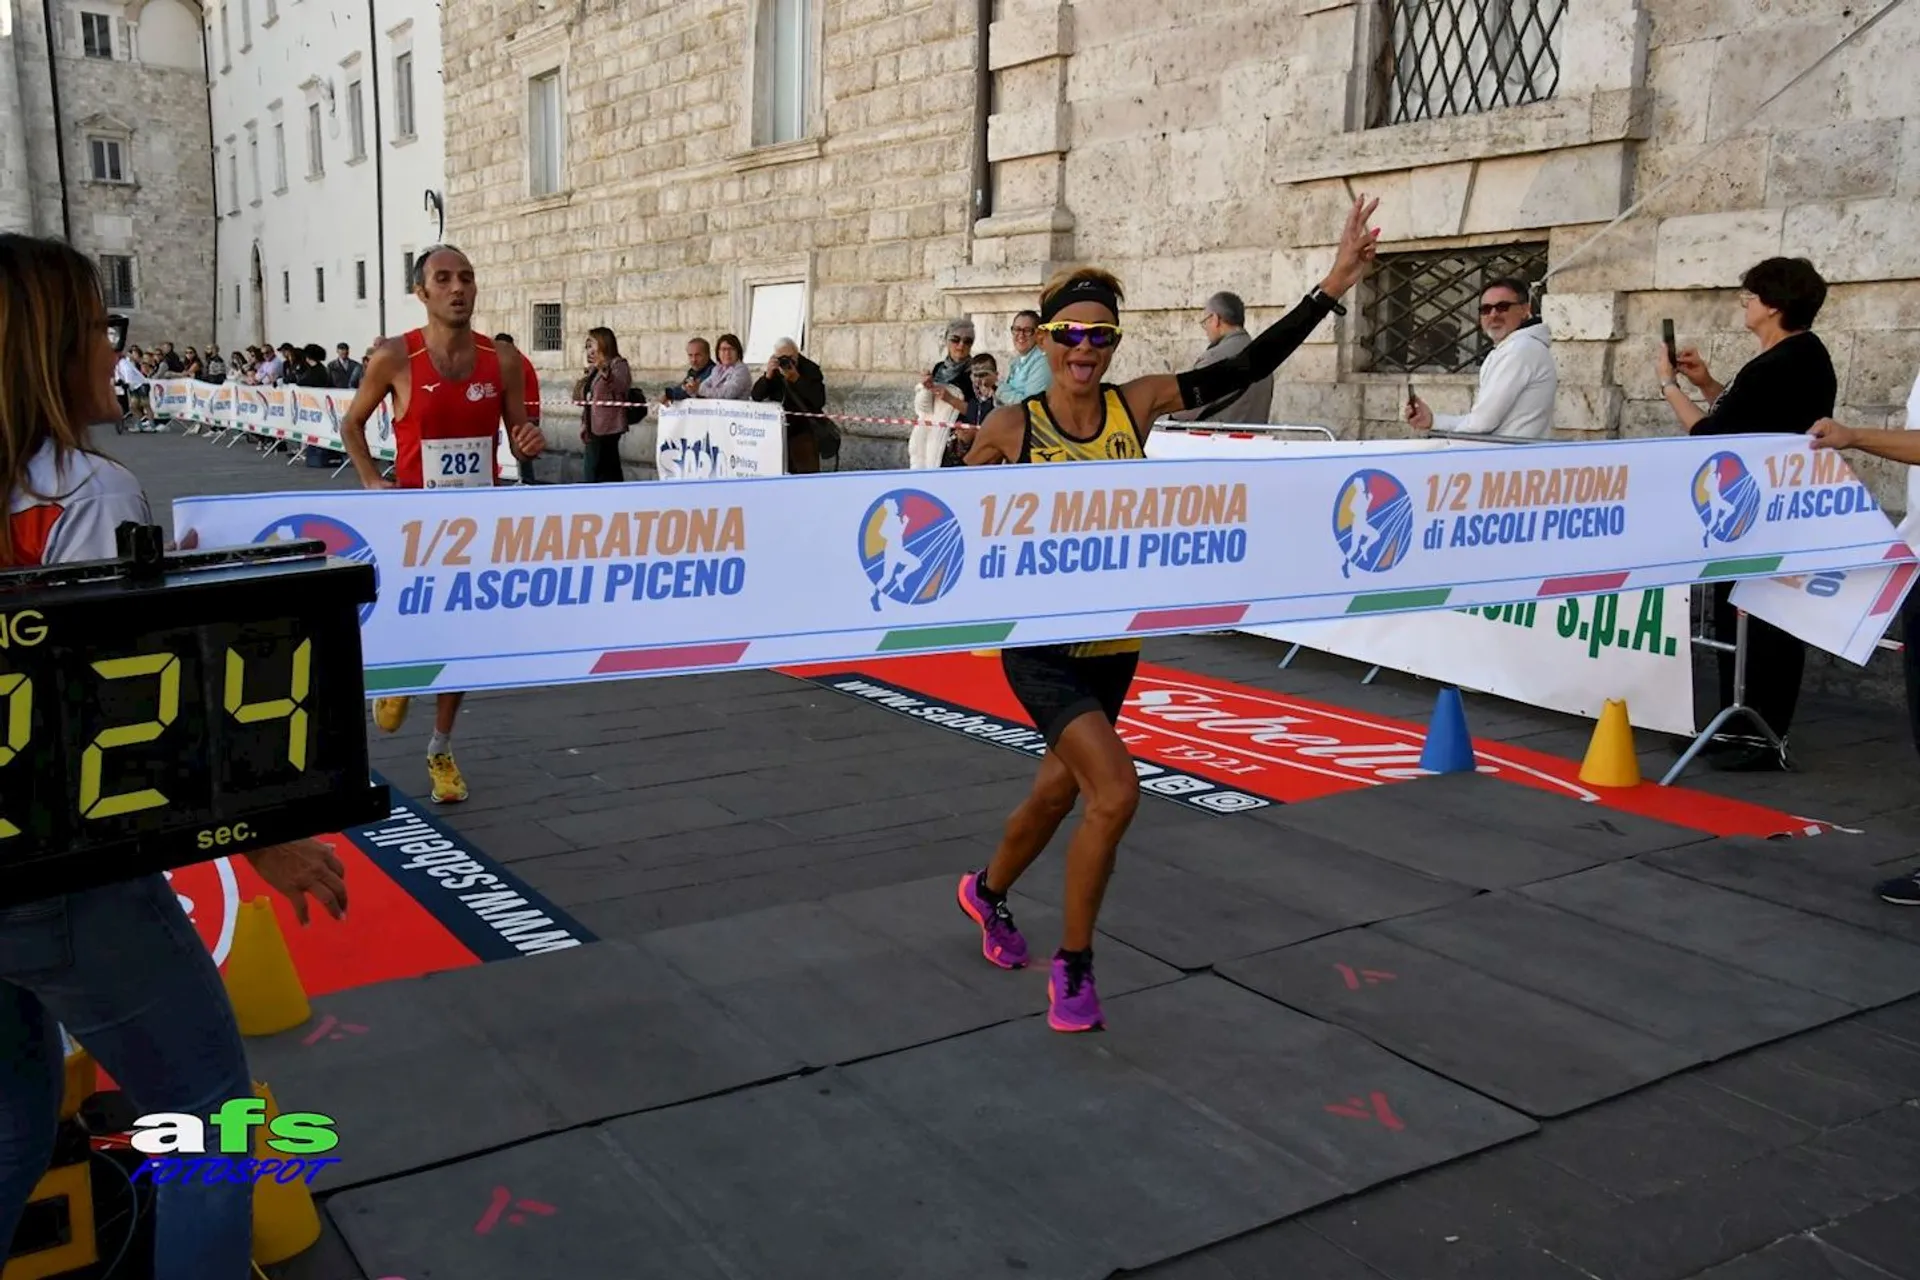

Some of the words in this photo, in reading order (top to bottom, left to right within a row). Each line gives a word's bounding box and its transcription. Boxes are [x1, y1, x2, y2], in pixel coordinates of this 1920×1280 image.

[441, 452, 480, 475] 282
[1764, 454, 1805, 488] 1/2
[980, 492, 1040, 537] 1/2
[1049, 483, 1248, 533] MARATONA
[1426, 471, 1473, 513] 1/2
[1479, 465, 1629, 510] MARATONA
[1766, 493, 1783, 522] di
[401, 517, 478, 568] 1/2
[490, 506, 746, 564] MARATONA
[1423, 518, 1444, 550] di
[1449, 510, 1538, 548] ASCOLI
[1541, 504, 1625, 541] PICENO
[979, 544, 1006, 580] di
[1014, 534, 1130, 577] ASCOLI
[1137, 528, 1247, 569] PICENO
[398, 575, 436, 616] di
[444, 565, 595, 613] ASCOLI
[603, 557, 746, 603] PICENO
[0, 610, 49, 649] G
[1556, 587, 1677, 660] S.p.A.
[834, 680, 1047, 756] www.sabelli.i
[1156, 744, 1268, 775] 1921
[197, 822, 258, 849] sec.
